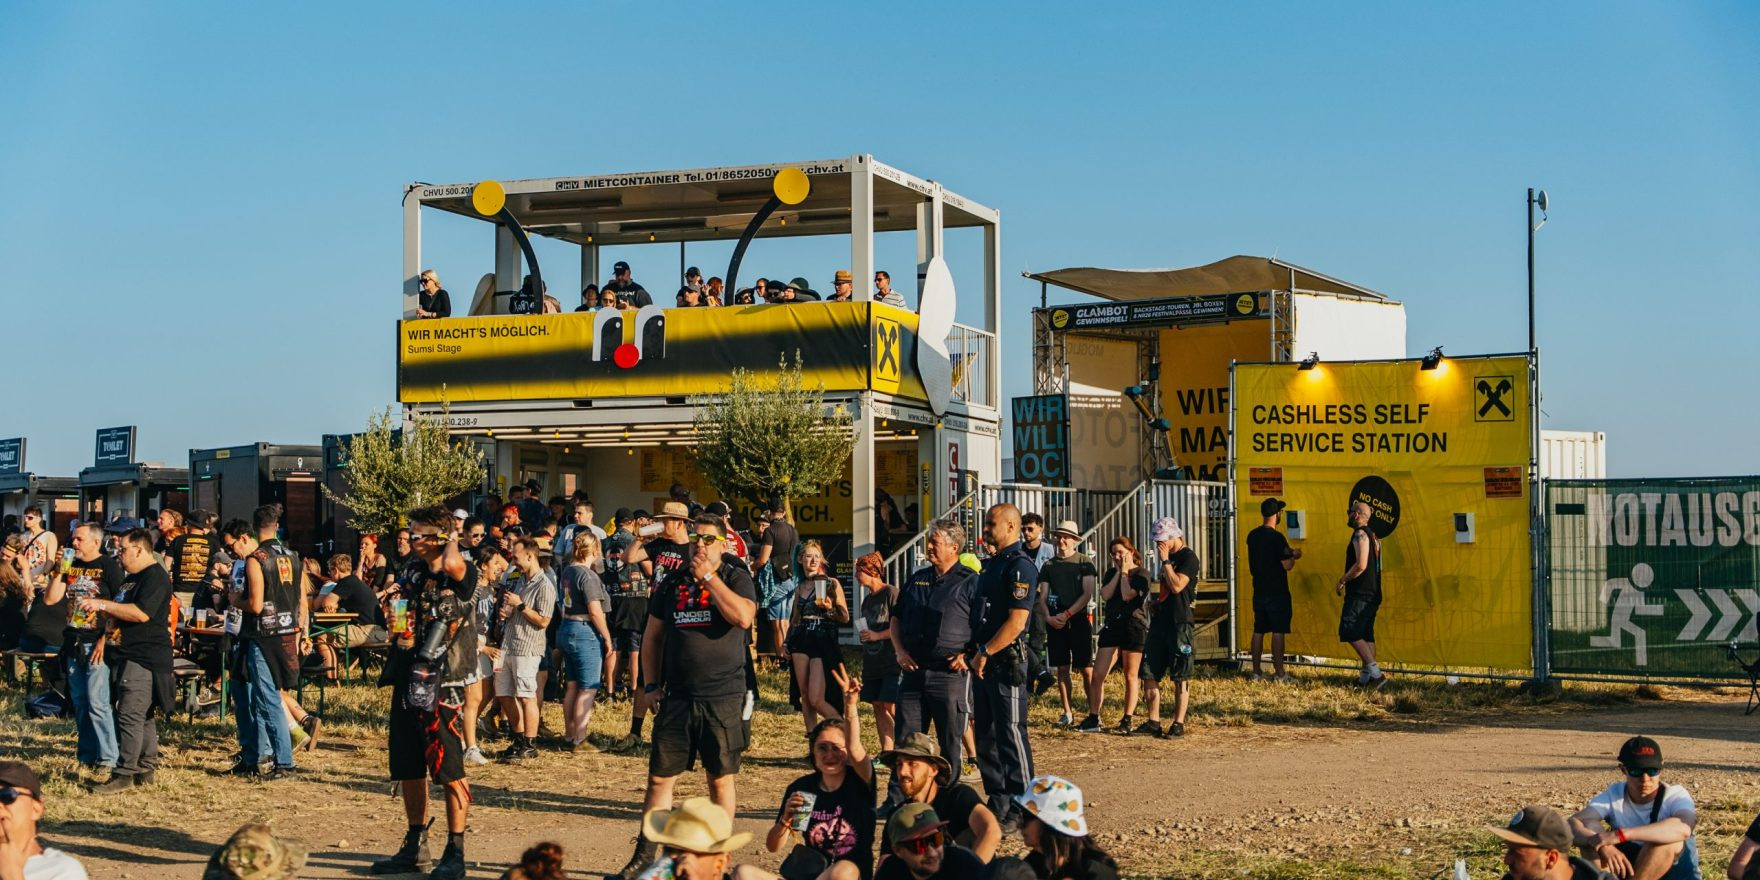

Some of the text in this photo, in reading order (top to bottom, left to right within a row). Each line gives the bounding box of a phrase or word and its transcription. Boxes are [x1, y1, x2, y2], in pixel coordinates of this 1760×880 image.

[584, 175, 680, 188] MIETCONTAINER
[423, 188, 444, 198] CHVU
[1076, 305, 1129, 318] GLAMBOT
[1076, 315, 1128, 325] GEWINNSPIEL!
[408, 324, 550, 340] WIR MACHT'S MÖGLICH.
[407, 343, 462, 354] Sumsi Stage
[1013, 396, 1063, 423] WIR
[1252, 403, 1430, 425] CASHLESS SELF
[1252, 432, 1448, 453] SERVICE STATION
[1360, 492, 1371, 503] NO
[1372, 498, 1392, 513] CASH
[1375, 510, 1394, 523] ONLY
[656, 555, 683, 571] PARTY
[673, 610, 711, 619] UNDER
[674, 617, 712, 625] ARMOUR
